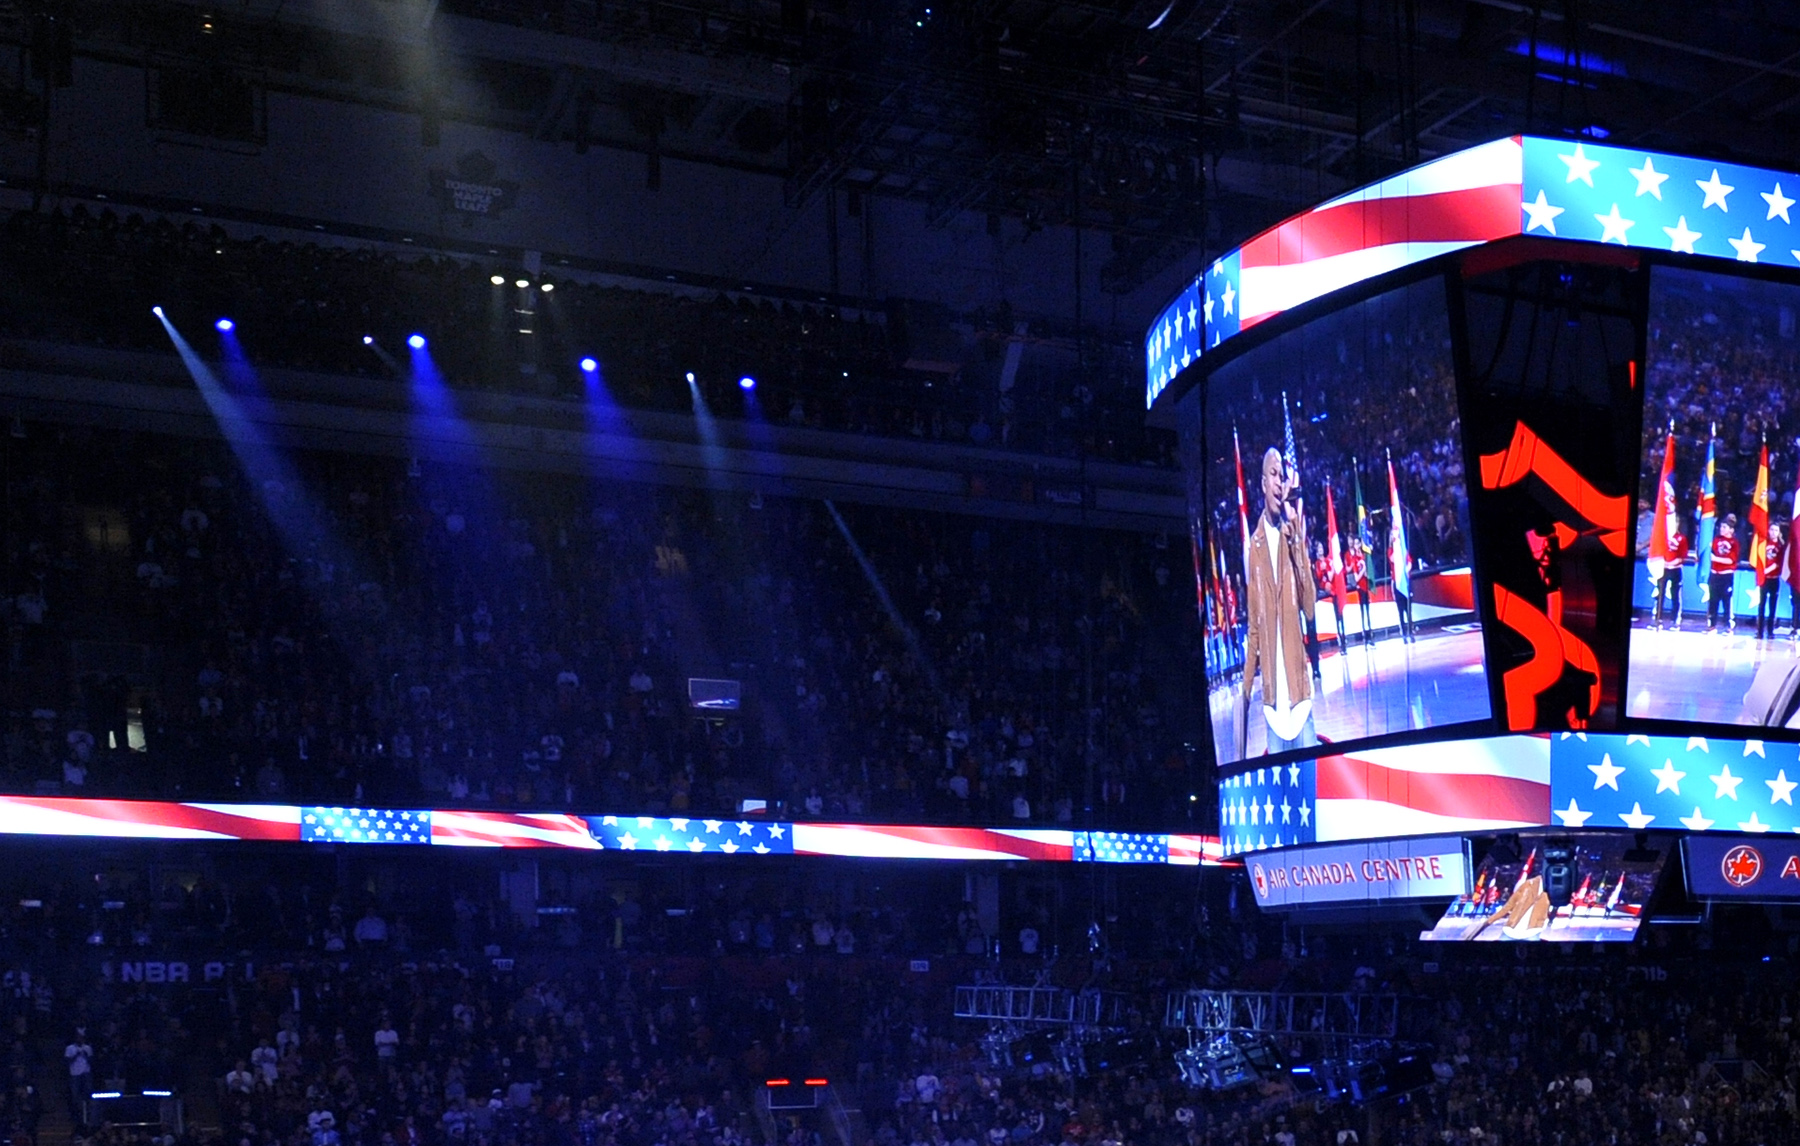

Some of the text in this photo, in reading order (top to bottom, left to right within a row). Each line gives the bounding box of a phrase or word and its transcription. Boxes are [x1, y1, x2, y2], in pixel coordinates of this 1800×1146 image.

[1268, 855, 1444, 889] AIR CANADA CENTRE
[121, 961, 190, 983] NBA
